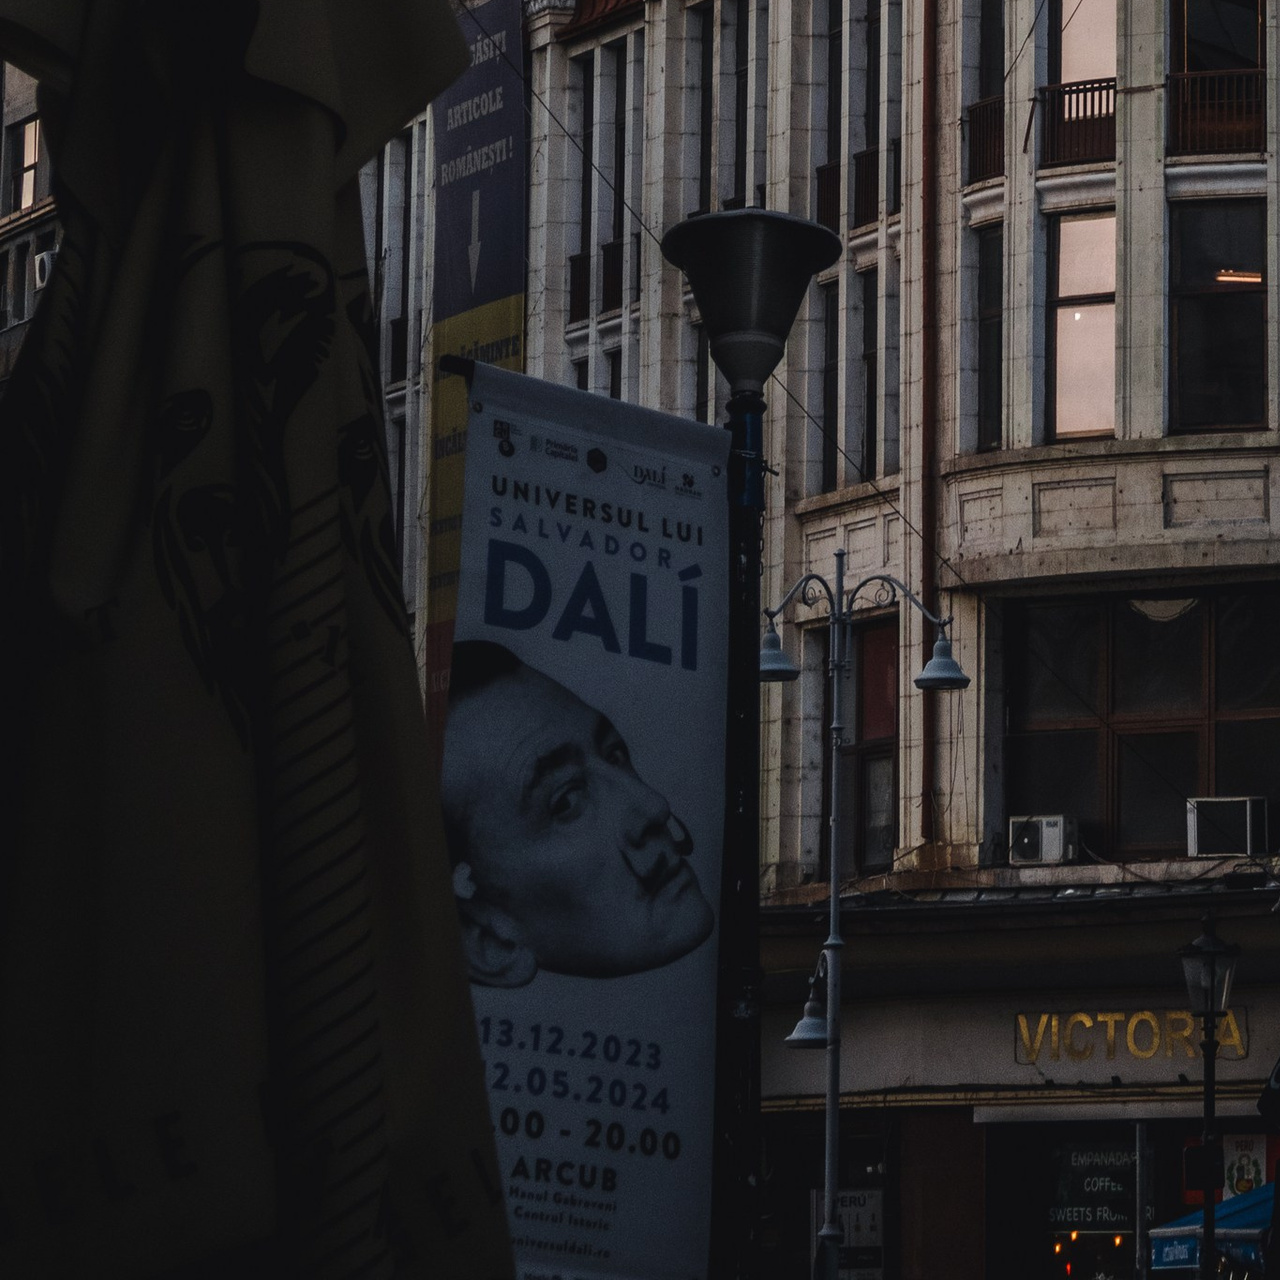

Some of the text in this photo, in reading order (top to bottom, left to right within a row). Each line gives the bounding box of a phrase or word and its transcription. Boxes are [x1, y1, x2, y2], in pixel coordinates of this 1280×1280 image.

[446, 86, 504, 131] ARTICOLE
[491, 475, 703, 546] UNIVERSUL LUI
[489, 507, 672, 569] SALVADOR
[484, 538, 703, 672] DALÍ
[479, 1016, 662, 1071] 13.12.2023
[483, 1059, 671, 1115] 2.05.2024
[584, 1119, 681, 1161] 20.00
[508, 1186, 549, 1202] Hanul
[510, 1156, 618, 1192] ARCUB
[513, 1206, 610, 1231] Centrul Istoric
[1049, 1206, 1093, 1222] SWEETS
